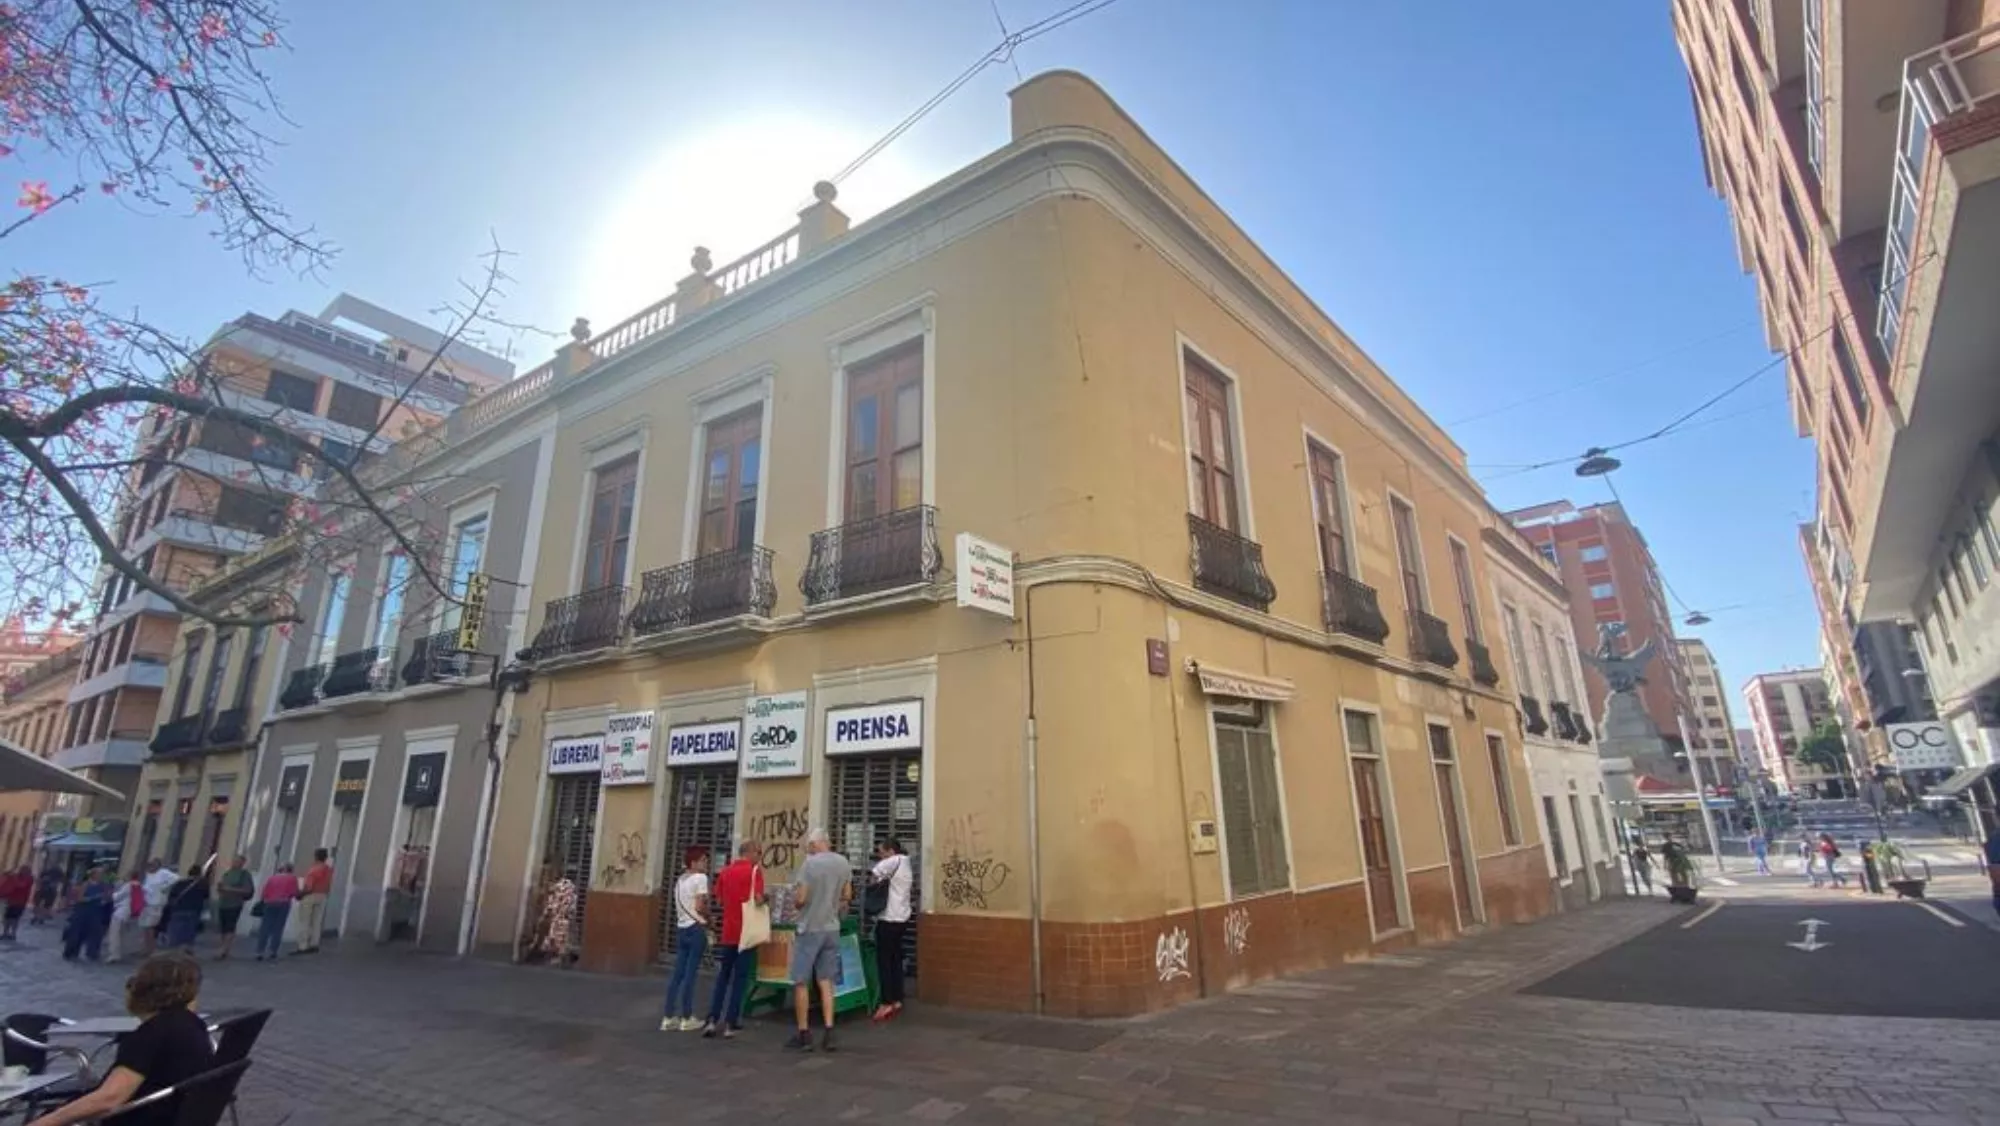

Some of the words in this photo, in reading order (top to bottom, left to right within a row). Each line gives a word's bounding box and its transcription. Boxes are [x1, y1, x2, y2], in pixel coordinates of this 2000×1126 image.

[609, 715, 652, 733] FOTOCOPIAS
[836, 714, 909, 743] PRENSA
[552, 743, 599, 765] LIBRERIA
[670, 730, 736, 756] PAPELERIA
